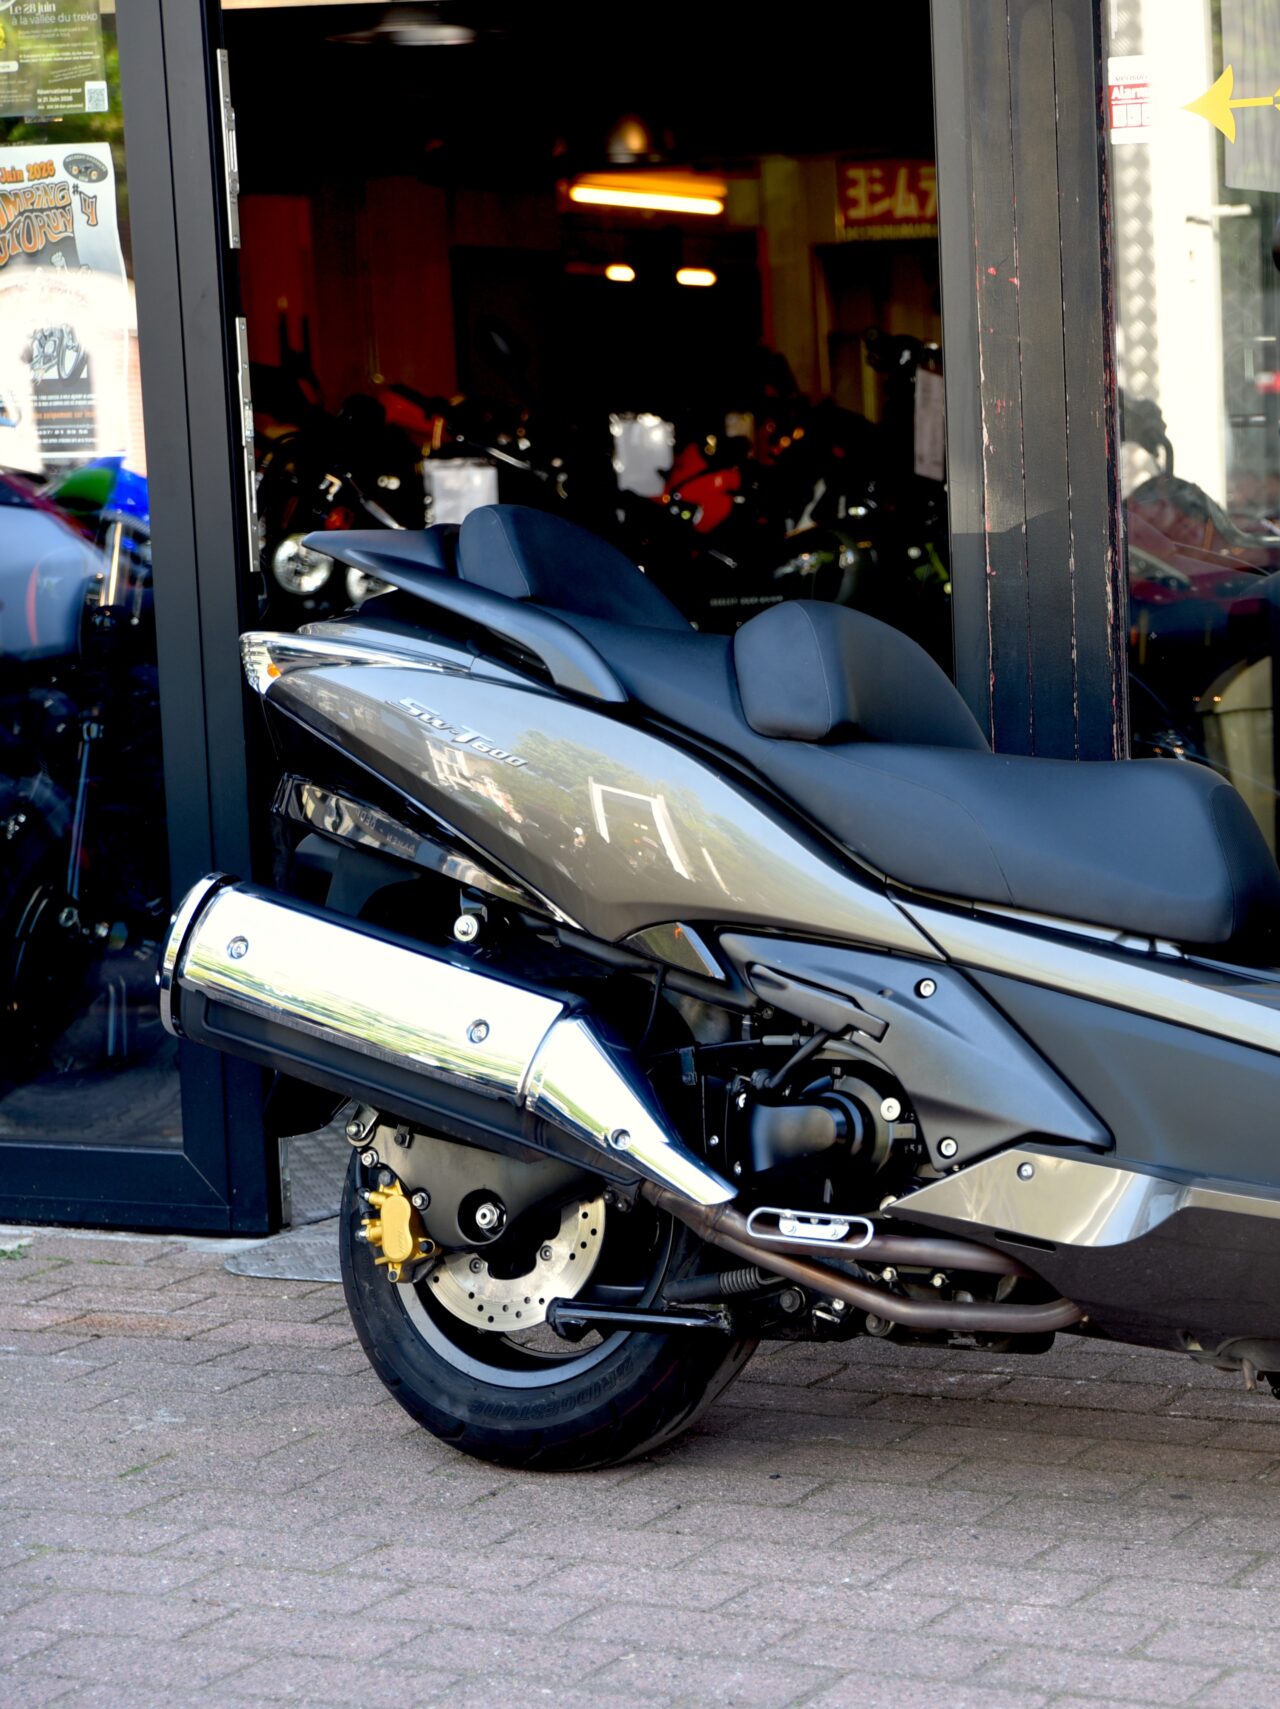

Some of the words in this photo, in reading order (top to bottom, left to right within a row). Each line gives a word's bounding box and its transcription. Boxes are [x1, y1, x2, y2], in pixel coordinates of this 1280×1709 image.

[23, 3, 37, 14] 28
[19, 15, 28, 25] la
[58, 12, 72, 23] du
[26, 160, 56, 181] 2026
